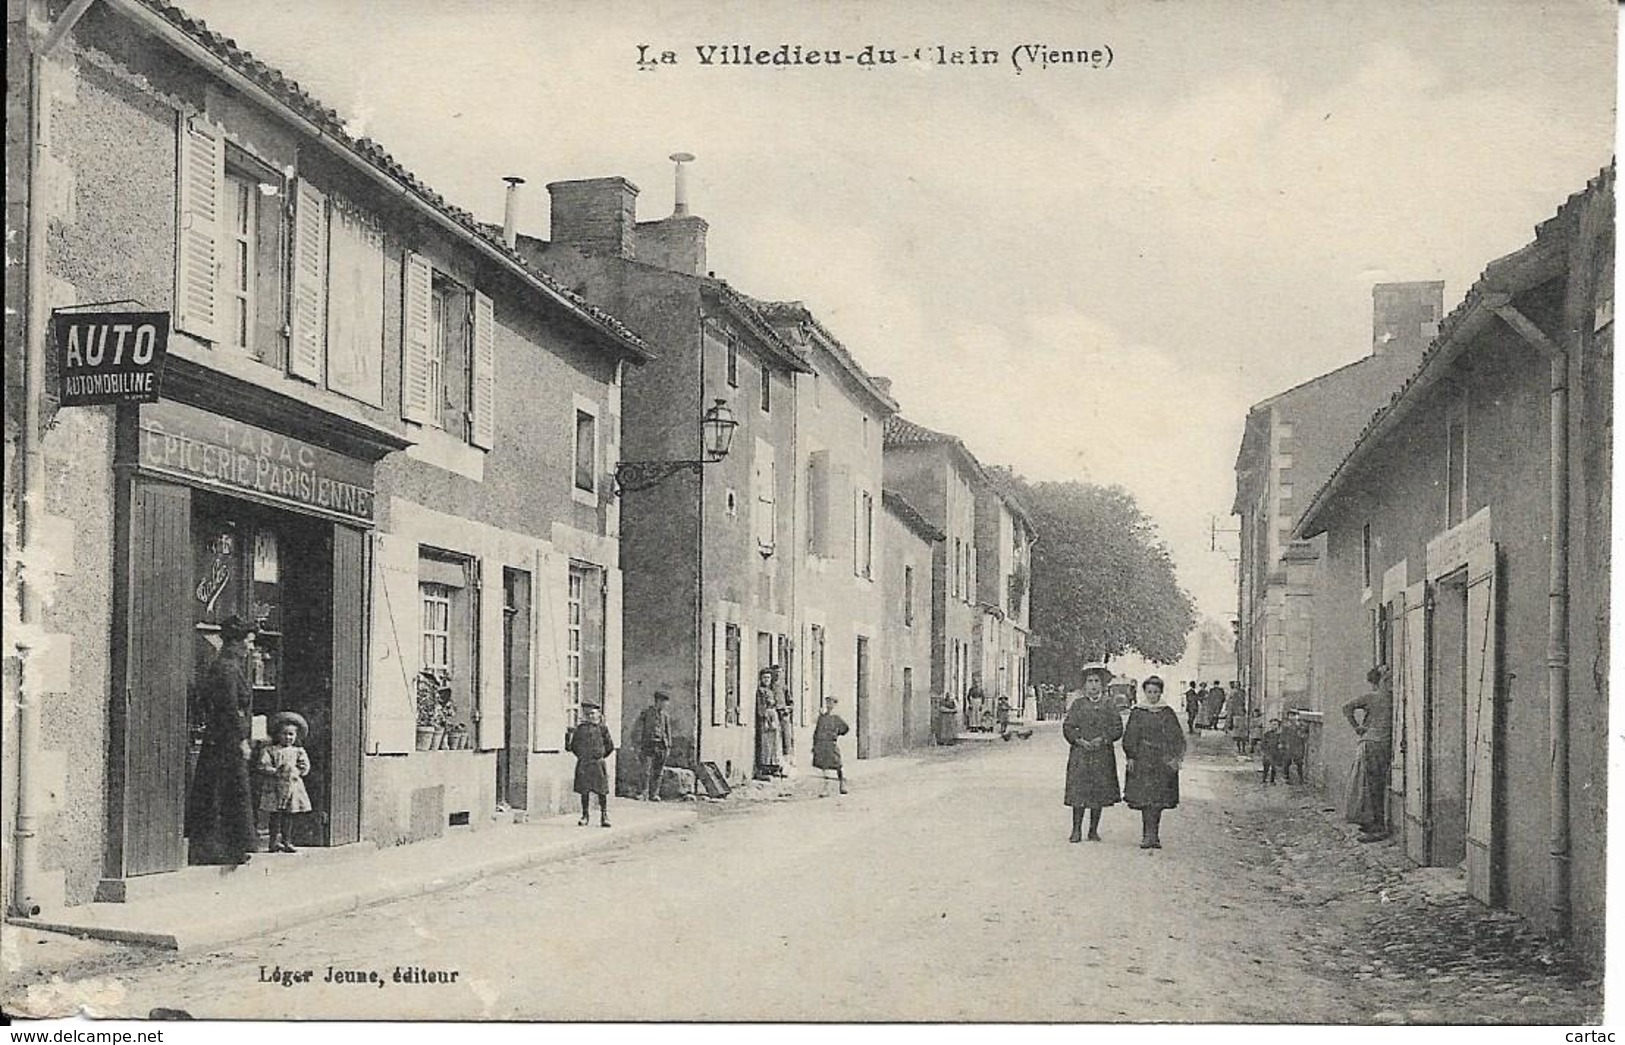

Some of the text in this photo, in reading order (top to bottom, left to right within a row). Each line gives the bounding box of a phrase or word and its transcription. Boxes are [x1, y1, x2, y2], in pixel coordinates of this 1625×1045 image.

[66, 324, 156, 367] AUTO
[65, 372, 153, 395] AUTOMOBILINE
[217, 420, 315, 468] TABAC
